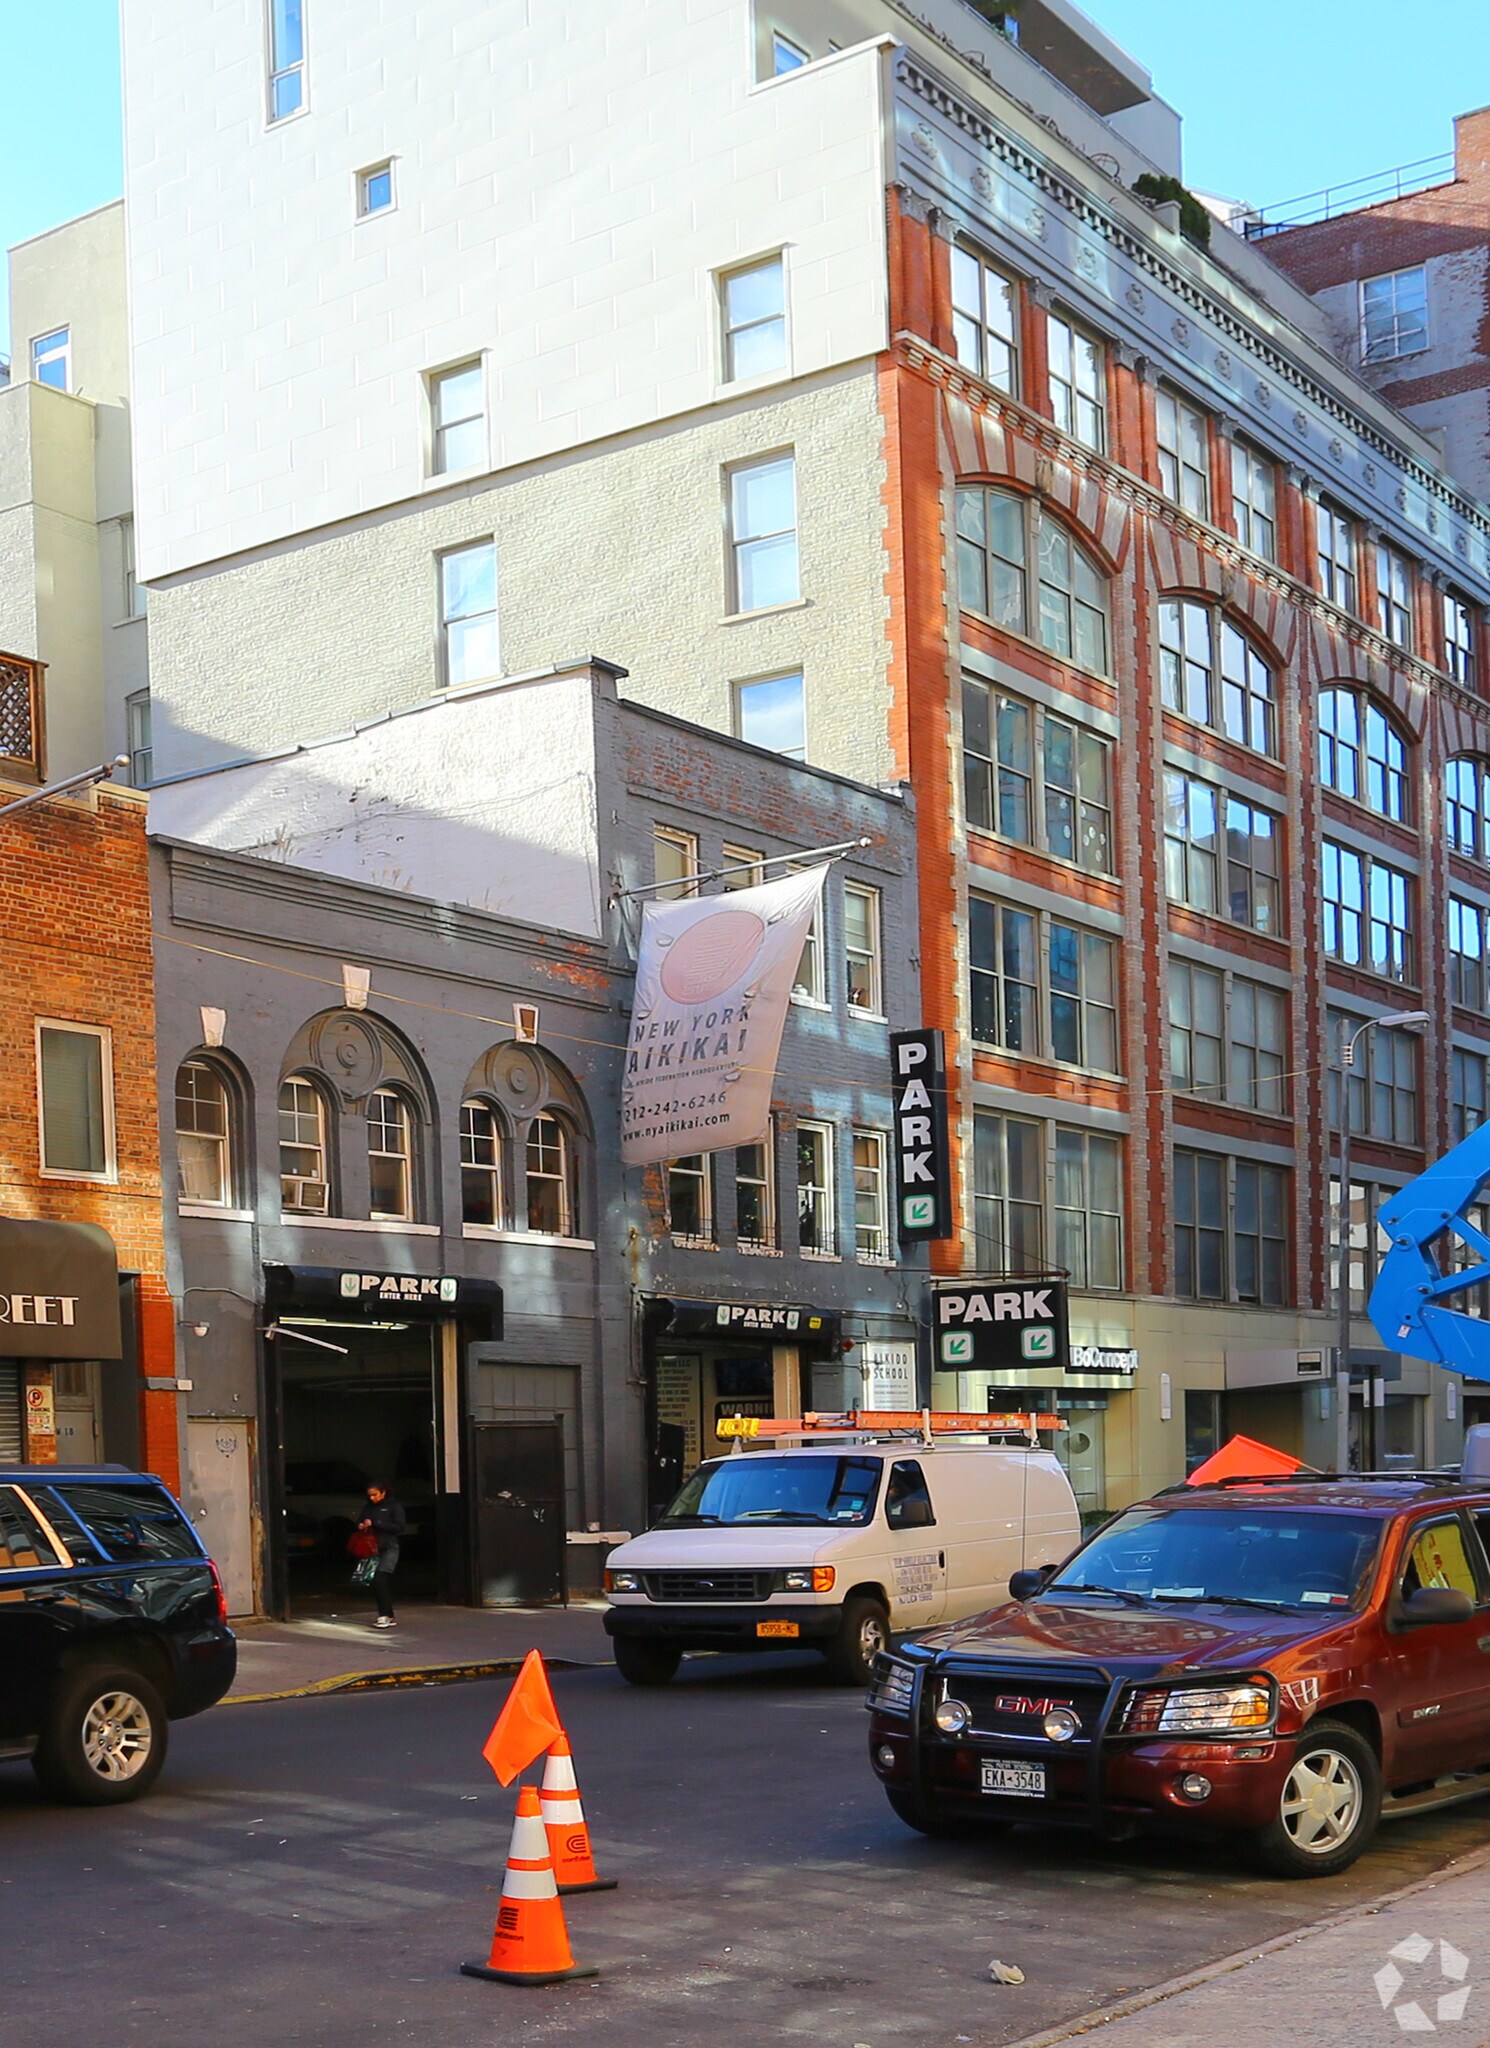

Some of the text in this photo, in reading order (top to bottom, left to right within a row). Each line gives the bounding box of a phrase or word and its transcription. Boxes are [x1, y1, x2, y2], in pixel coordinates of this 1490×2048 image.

[634, 1004, 752, 1043] NEW YORK
[628, 1028, 748, 1074] AIKIKAI
[622, 1112, 731, 1142] www.nyaikikai.com
[898, 1042, 935, 1184] PARK
[361, 1274, 440, 1295] PARK
[731, 1306, 786, 1324] PARK
[939, 1289, 1055, 1325] PARK
[873, 1367, 908, 1380] SCHOOL
[1070, 1346, 1139, 1374] BoConcept
[720, 1402, 774, 1417] WARNI
